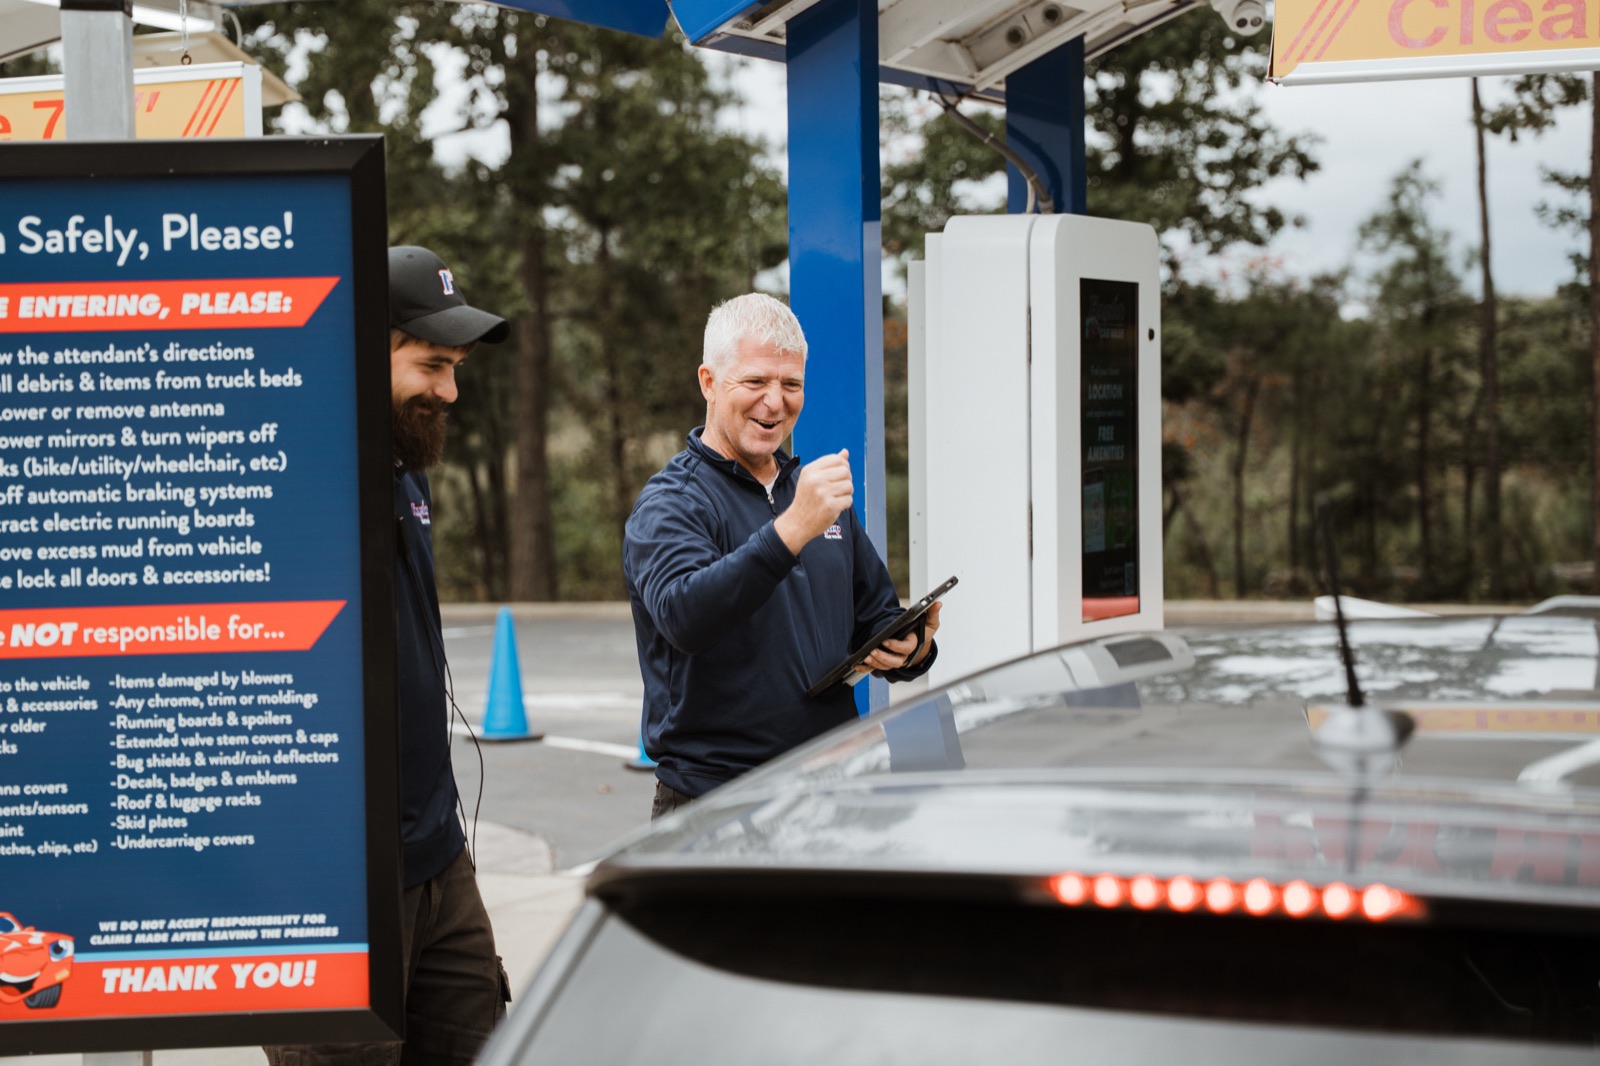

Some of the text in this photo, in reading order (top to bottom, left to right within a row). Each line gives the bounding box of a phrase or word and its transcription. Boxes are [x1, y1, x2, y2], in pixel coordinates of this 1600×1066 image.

[1388, 0, 1600, 49] Clea
[18, 215, 149, 266] Safely,
[163, 211, 293, 251] Please!
[18, 294, 170, 319] ENTERING,
[181, 291, 292, 315] PLEASE:
[17, 345, 49, 365] the
[54, 343, 159, 364] attendant's
[163, 342, 254, 362] directions
[0, 367, 302, 393] ll debris & items from truck beds
[0, 402, 224, 421] ower or remove antenna
[0, 423, 278, 451] ower mirrors & turn wipers off
[0, 451, 287, 481] ks (bike/utility/wheelchair, etc)
[28, 483, 121, 504] automatic
[126, 482, 196, 507] braking
[200, 484, 273, 506] systems
[0, 507, 255, 535] ract electric running boards
[0, 535, 262, 561] ove excess mud from vehicle
[0, 562, 270, 589] e lock all doors & accessories!
[10, 622, 78, 647] NOT
[83, 616, 221, 651] responsible
[15, 677, 39, 692] the
[41, 675, 90, 690] vehicle
[157, 671, 219, 691] damaged
[222, 671, 239, 690] by
[242, 670, 293, 685] blowers
[6, 697, 19, 713] &
[22, 696, 98, 712] accessories
[147, 693, 204, 709] chrome,
[207, 692, 236, 706] trim
[239, 695, 254, 705] or
[257, 690, 318, 709] moldings
[0, 718, 46, 733] r older
[178, 712, 223, 727] boards
[227, 711, 239, 726] &
[241, 710, 292, 730] spoilers
[0, 740, 18, 754] ks
[181, 732, 214, 746] valve
[217, 734, 249, 746] stem
[251, 734, 293, 745] covers
[296, 729, 307, 743] &
[310, 733, 339, 747] caps
[146, 752, 191, 768] shields
[194, 752, 206, 766] &
[209, 751, 271, 765] wind/rain
[273, 749, 339, 764] deflectors
[23, 784, 68, 795] covers
[170, 772, 218, 792] badges
[221, 771, 233, 786] &
[236, 770, 297, 785] emblems
[0, 801, 88, 816] ents/sensors
[155, 793, 167, 809] &
[170, 794, 222, 813] luggage
[225, 791, 261, 806] racks
[149, 814, 188, 833] plates
[0, 839, 98, 857] tches, chips, etc)
[213, 835, 255, 846] covers
[99, 914, 326, 931] WE DO NOT ACCEPT RESPONSIBILITY FOR
[90, 927, 338, 945] CLAIMS MADE AFTER LEAVING THE PREMISES
[102, 960, 317, 993] THANK YOU!
